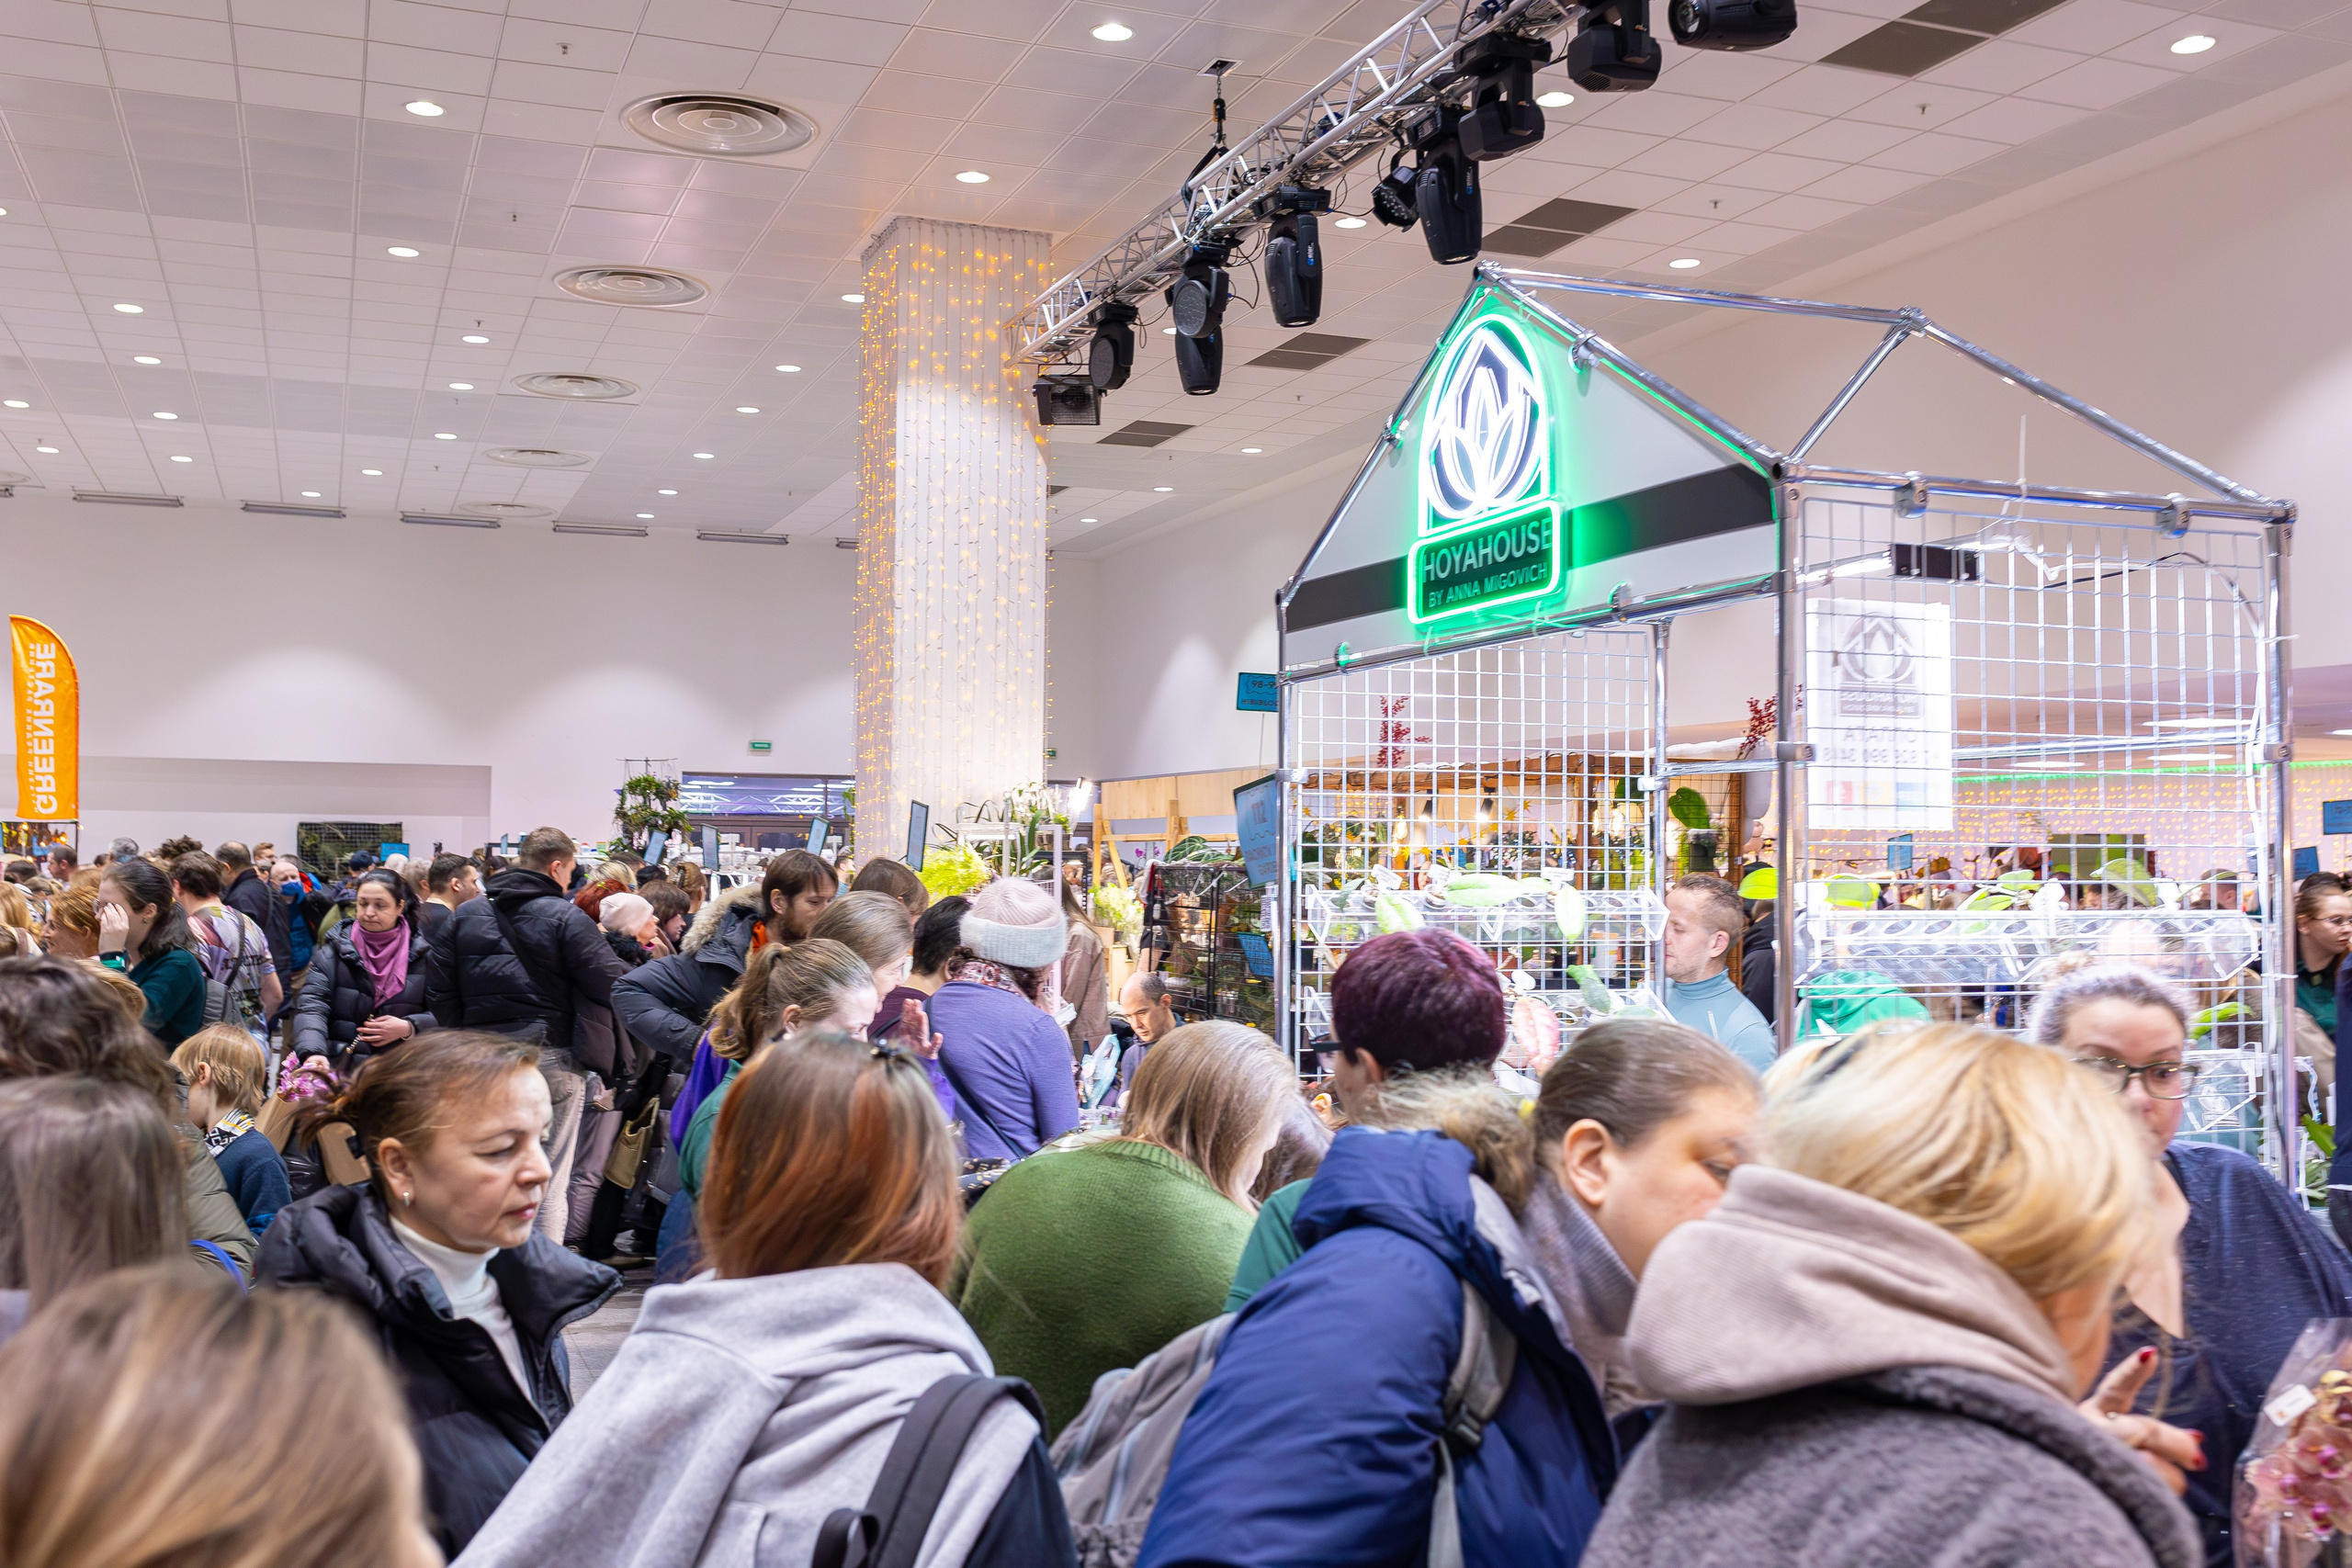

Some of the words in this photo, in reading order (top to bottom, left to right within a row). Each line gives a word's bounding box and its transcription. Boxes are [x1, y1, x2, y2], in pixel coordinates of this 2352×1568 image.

[1423, 516, 1552, 582] HOYAHOUSE
[1429, 590, 1444, 608] BY
[1446, 581, 1481, 604] ANNA
[1484, 562, 1547, 594] MIGOVICH
